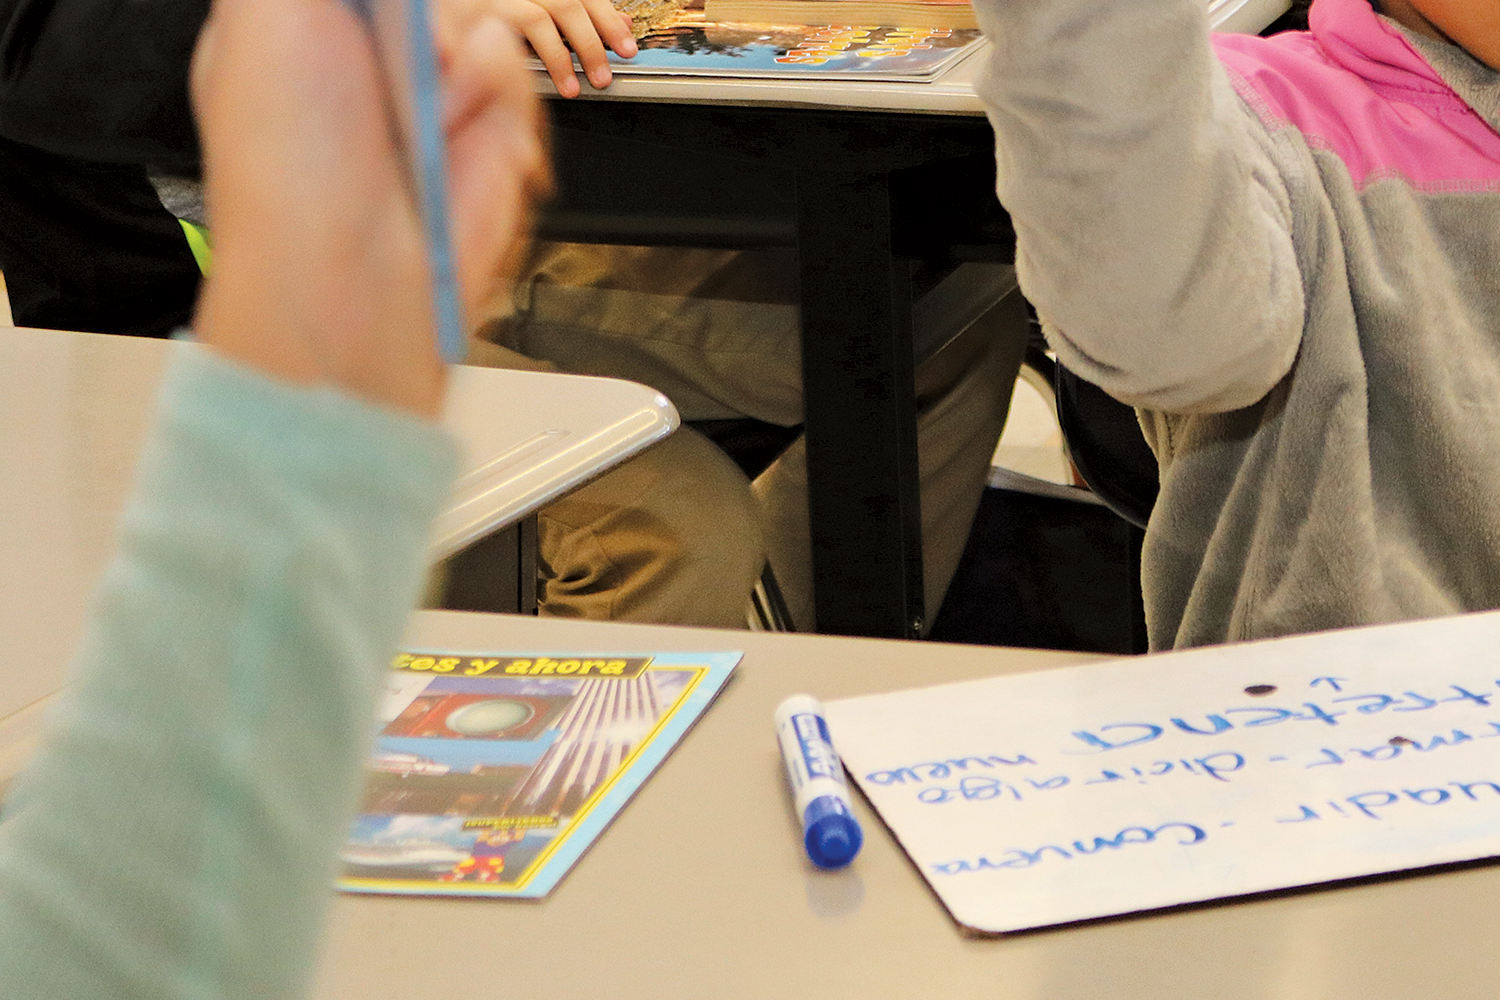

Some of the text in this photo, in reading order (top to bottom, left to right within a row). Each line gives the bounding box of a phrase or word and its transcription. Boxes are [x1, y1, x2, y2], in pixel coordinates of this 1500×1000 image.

[464, 658, 500, 676] y
[505, 657, 628, 676] ahora
[865, 755, 1038, 787] nuevo
